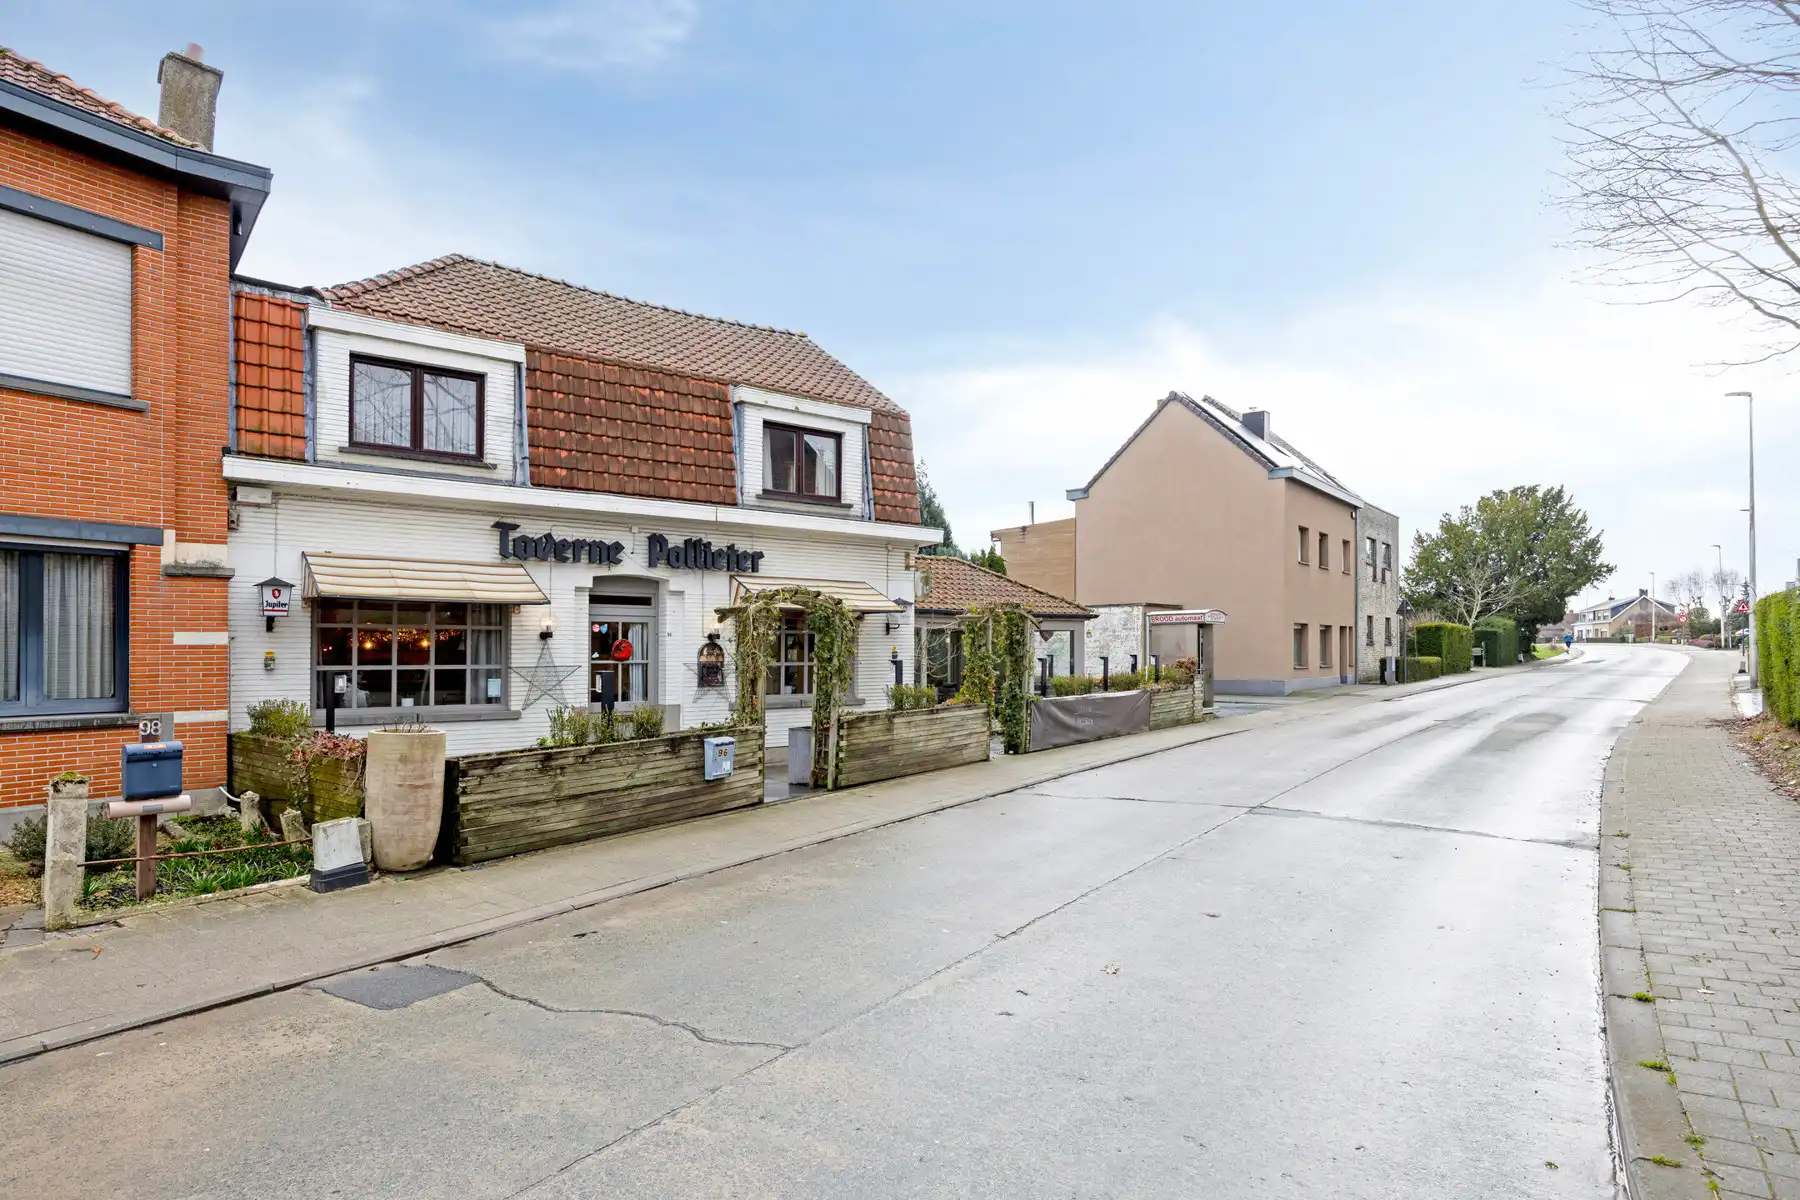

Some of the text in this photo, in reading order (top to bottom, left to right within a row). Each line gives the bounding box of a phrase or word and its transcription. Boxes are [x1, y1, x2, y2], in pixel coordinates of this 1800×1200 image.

[491, 521, 765, 573] Taverne Pallieter
[265, 600, 288, 609] Jupiler
[1150, 615, 1174, 623] BROOD
[1174, 614, 1204, 622] automaat
[139, 720, 162, 736] 98
[717, 748, 729, 758] 96
